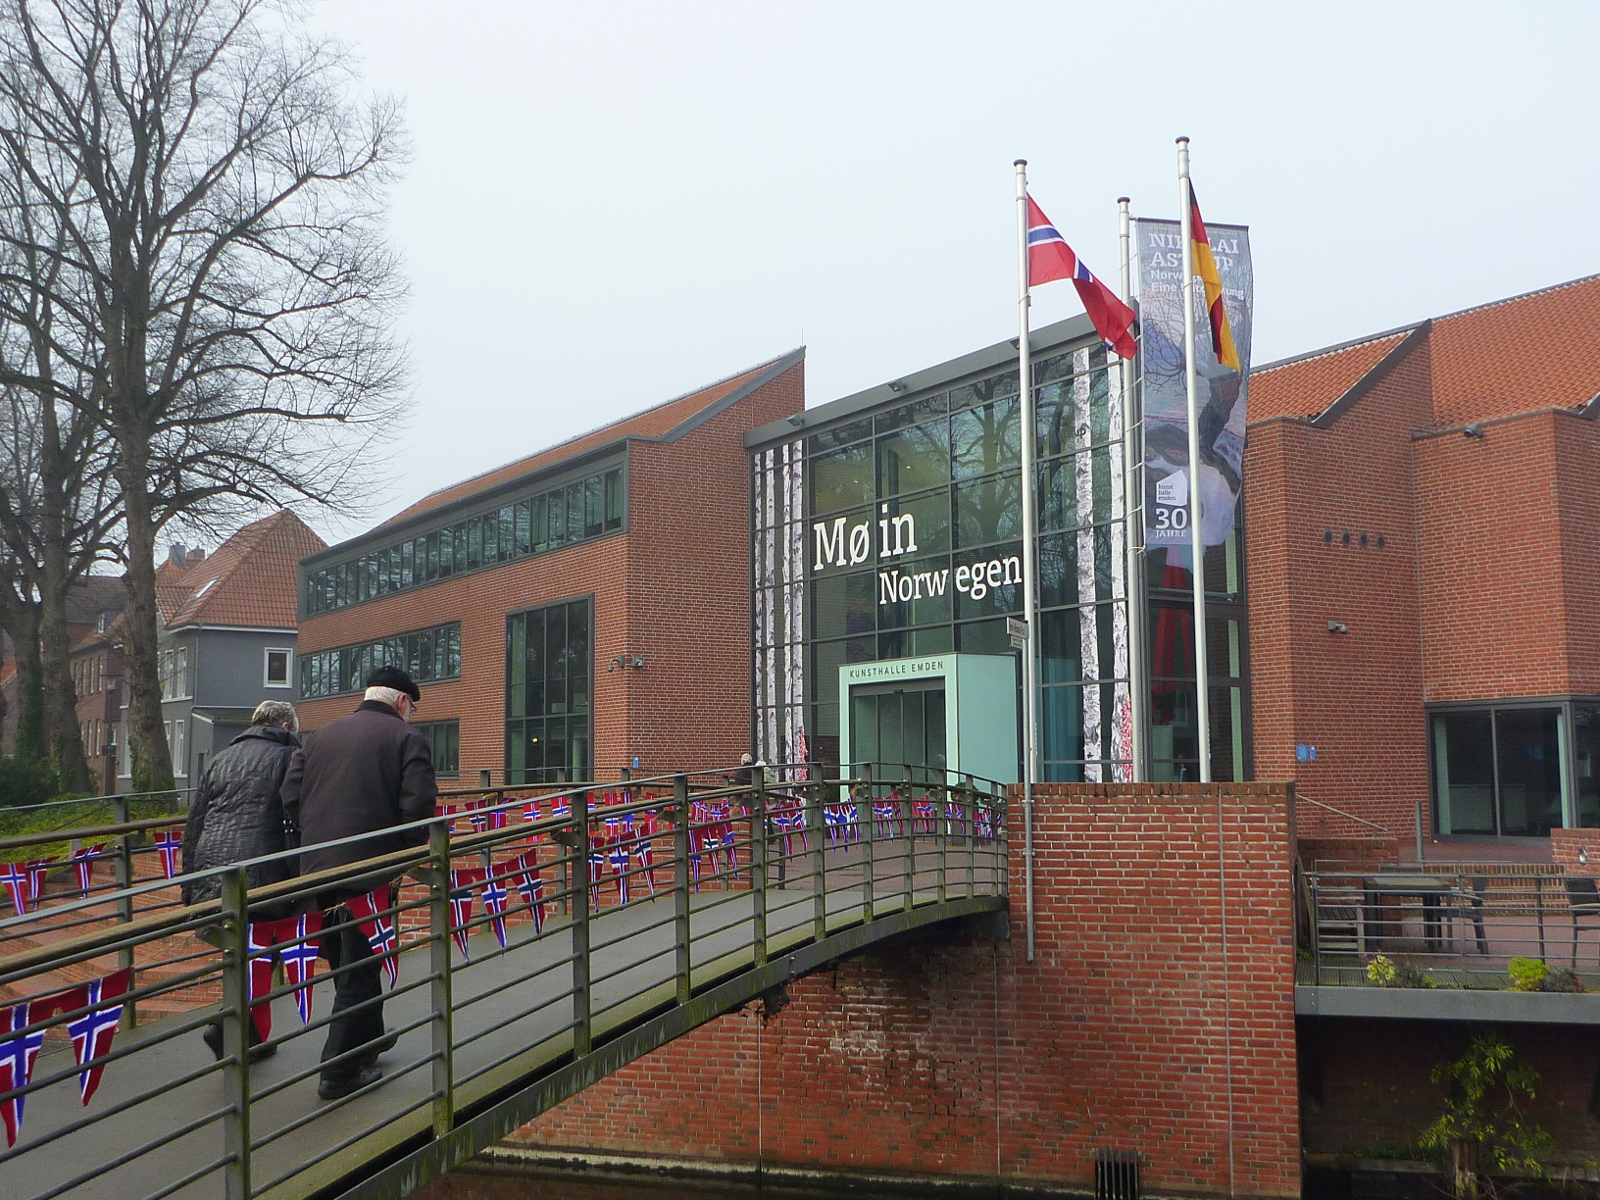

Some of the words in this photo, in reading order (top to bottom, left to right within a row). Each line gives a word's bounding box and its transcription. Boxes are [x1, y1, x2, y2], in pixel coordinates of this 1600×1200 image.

[1155, 508, 1188, 529] 30
[813, 516, 870, 571] Mø
[879, 503, 918, 558] in
[1156, 530, 1186, 538] JAHRE
[849, 664, 906, 678] KUNSTHALLE
[911, 660, 944, 673] EMDEN
